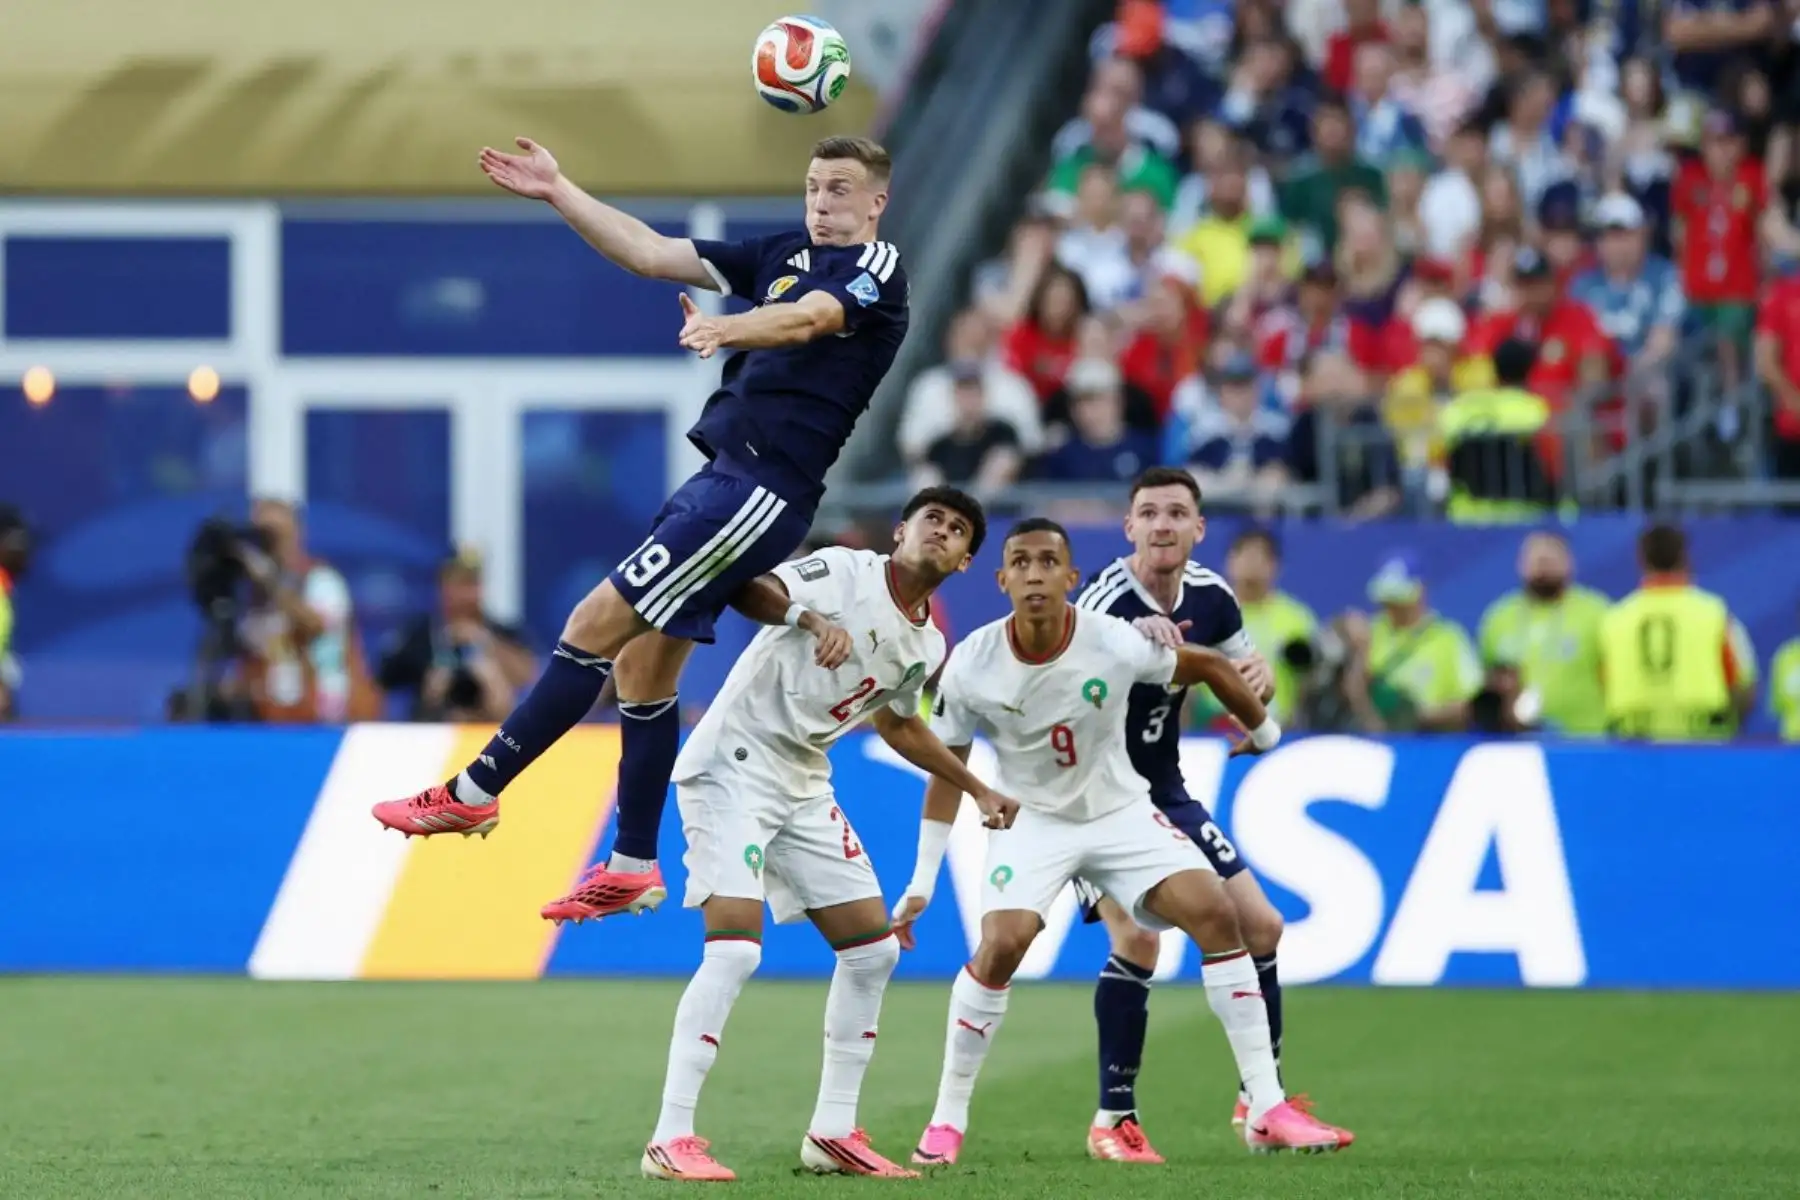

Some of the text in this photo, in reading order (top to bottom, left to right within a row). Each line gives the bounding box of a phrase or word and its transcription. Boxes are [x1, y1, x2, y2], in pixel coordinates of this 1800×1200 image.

[617, 535, 671, 587] 19
[829, 677, 885, 722] 2
[1051, 723, 1077, 768] 9
[1142, 706, 1170, 743] 3
[1200, 821, 1237, 863] 3
